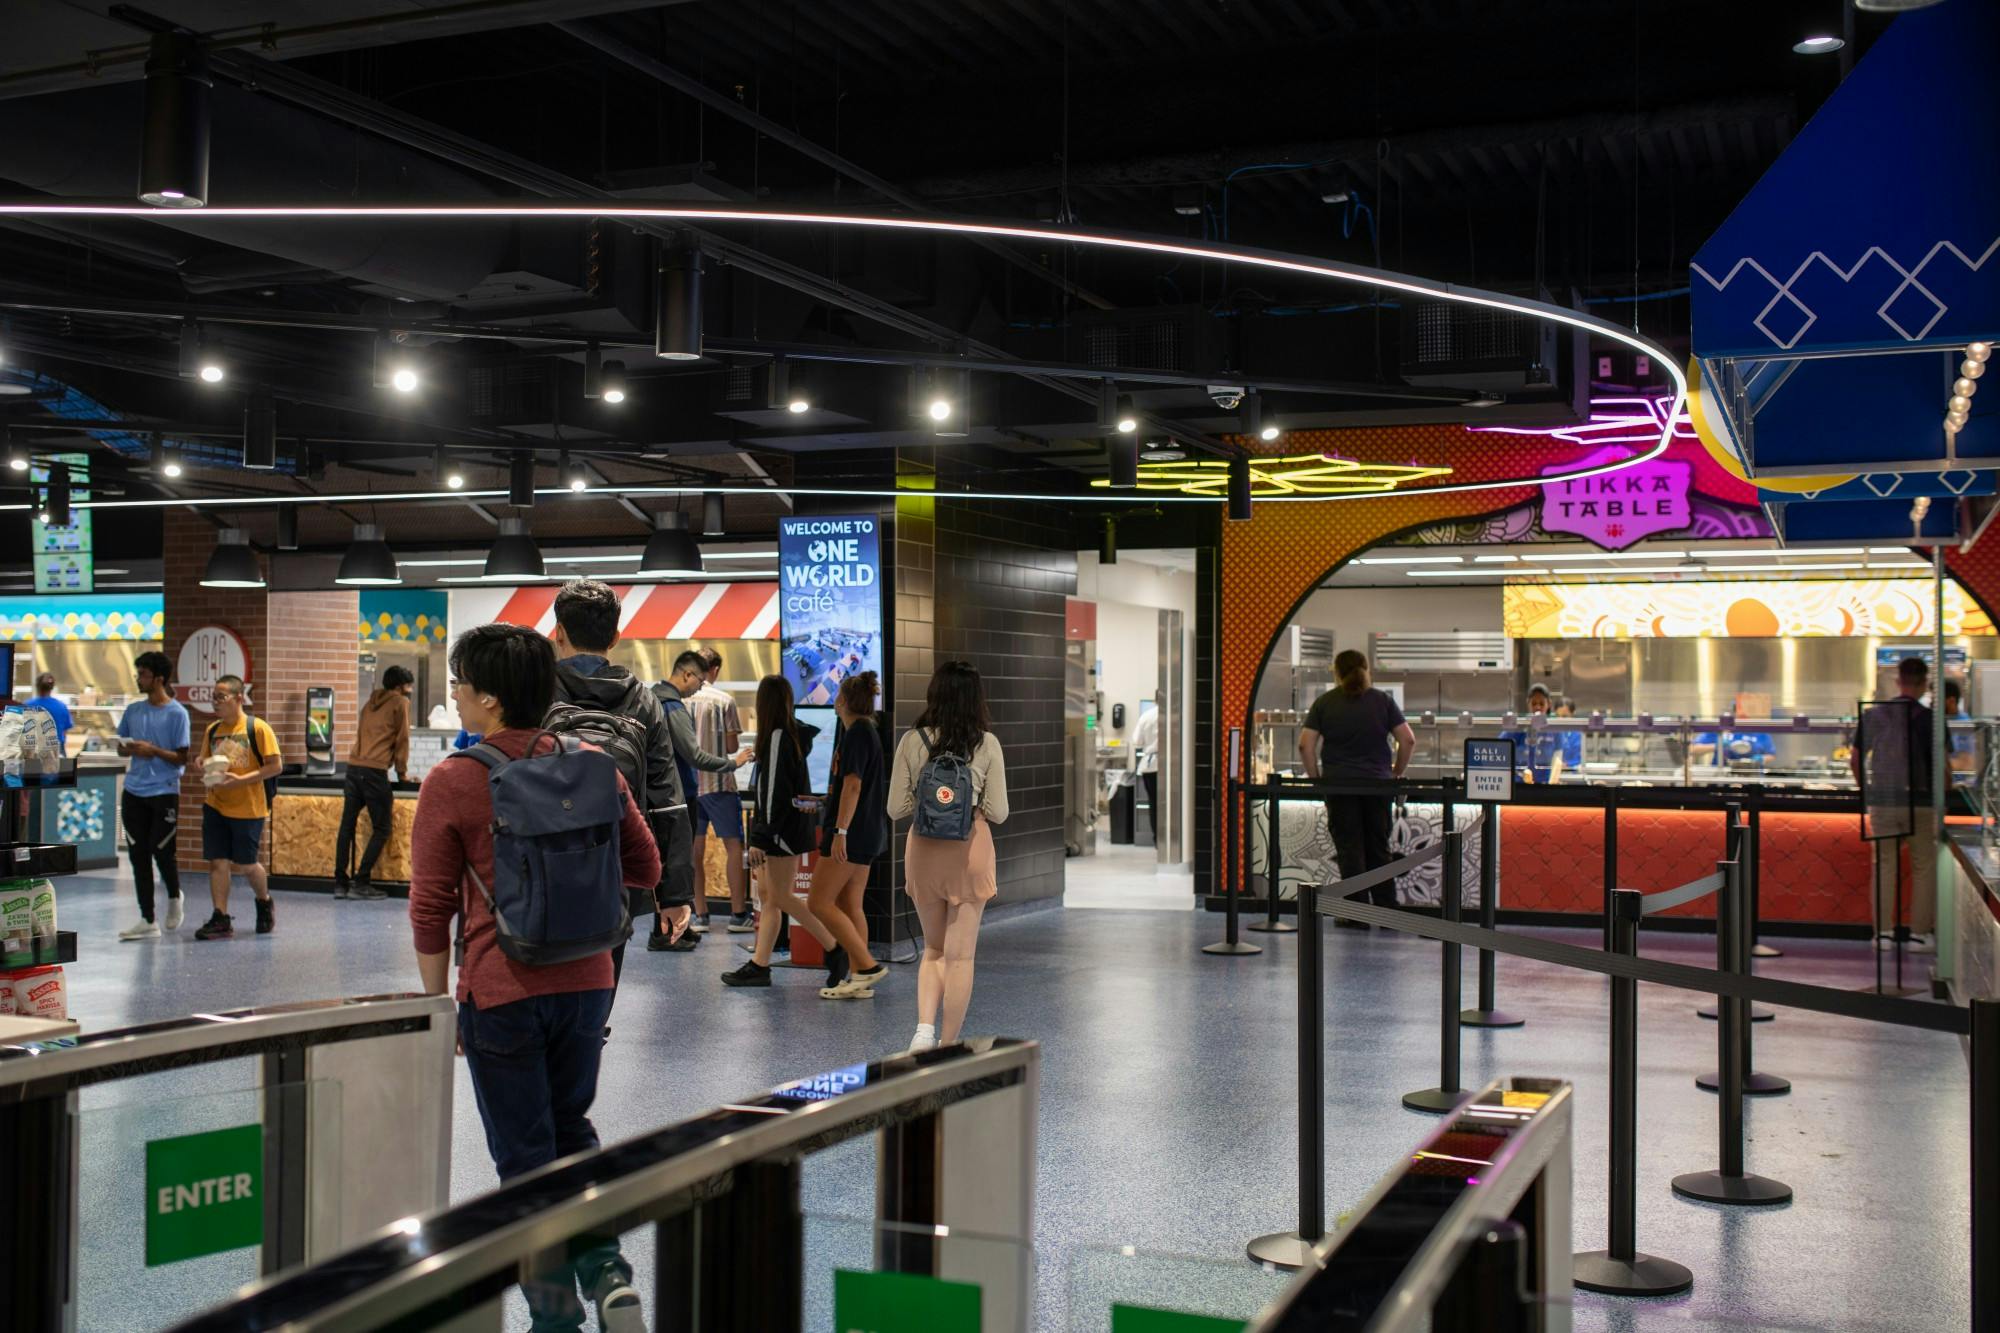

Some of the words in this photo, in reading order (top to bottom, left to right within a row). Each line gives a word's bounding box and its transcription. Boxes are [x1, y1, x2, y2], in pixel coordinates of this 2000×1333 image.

[1560, 475, 1671, 494] TIKKA
[1559, 499, 1672, 517] TABLE
[784, 521, 852, 535] WELCOME
[854, 520, 873, 533] TO
[808, 539, 859, 562] ONE
[785, 564, 874, 588] WORLD
[787, 589, 833, 612] café
[1473, 754, 1506, 762] OREXI
[1474, 747, 1498, 755] KALI
[1475, 775, 1503, 783] ENTER
[1477, 783, 1500, 791] HERE
[158, 1173, 253, 1215] ENTER
